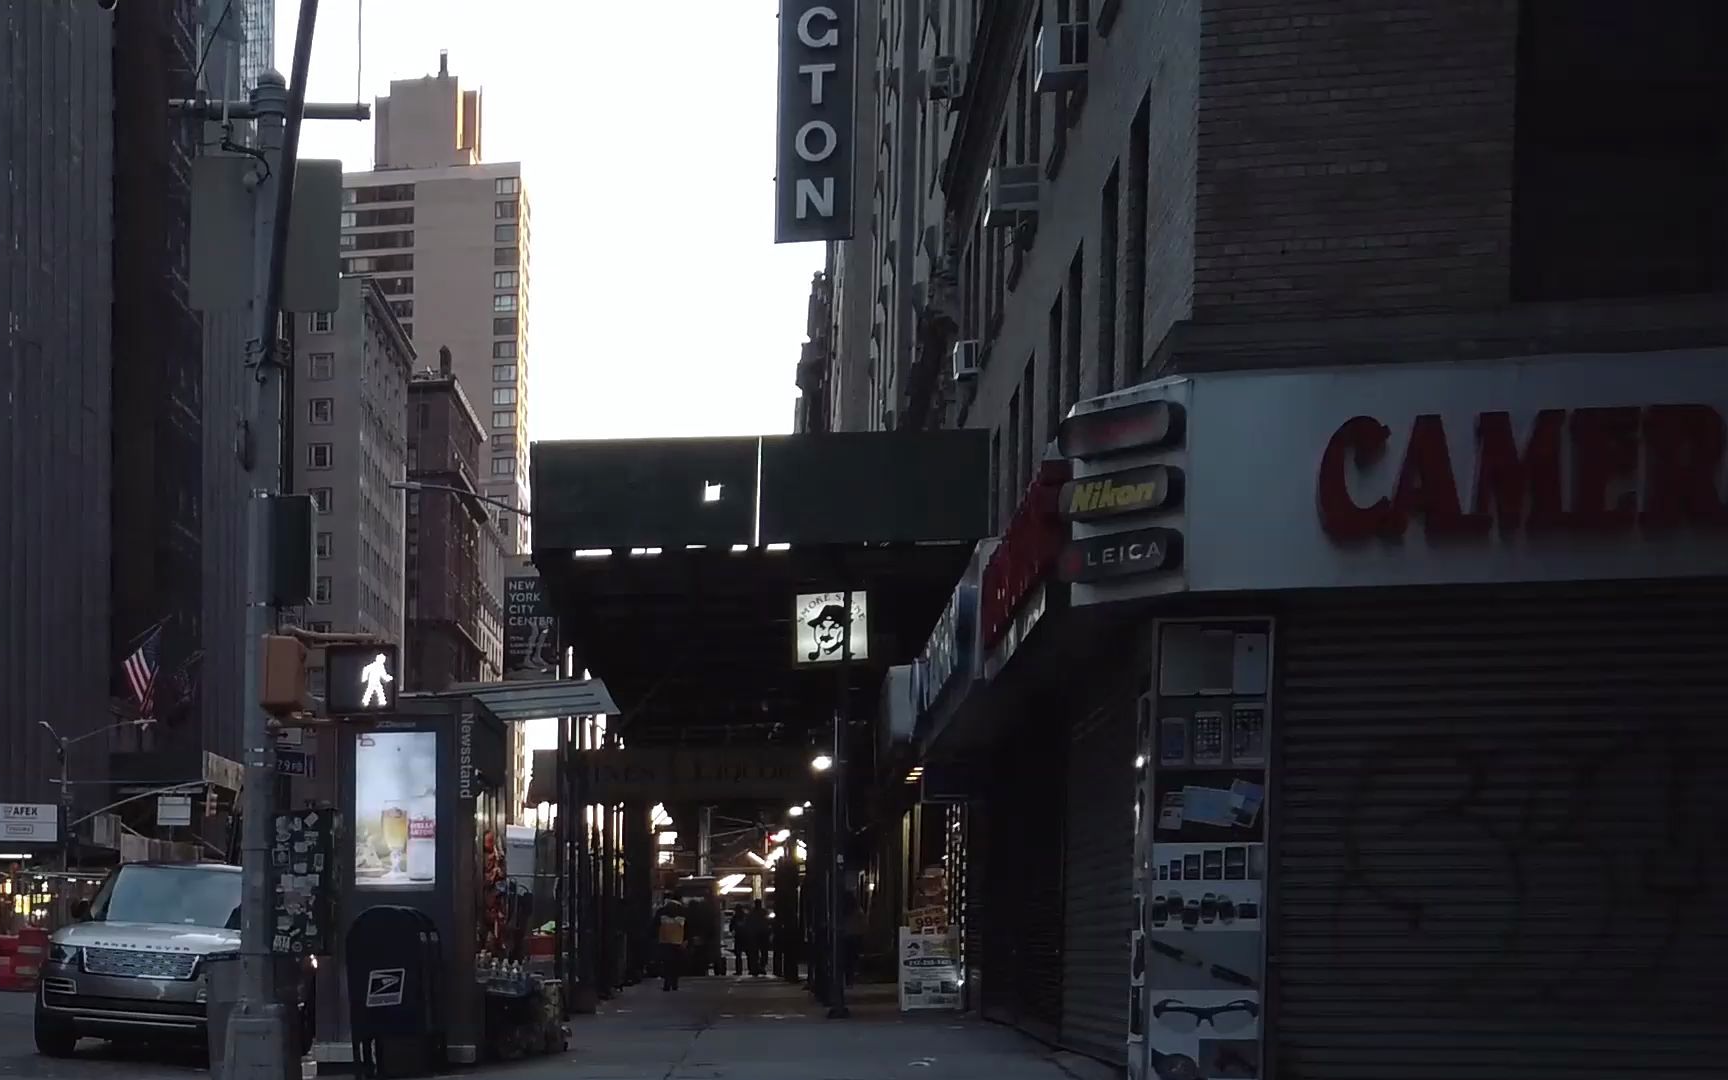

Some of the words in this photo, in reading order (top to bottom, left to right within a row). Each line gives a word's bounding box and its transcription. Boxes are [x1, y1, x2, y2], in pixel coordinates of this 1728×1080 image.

[1069, 479, 1155, 512] Nikon
[1087, 541, 1161, 567] LEICA
[509, 581, 536, 591] NEW
[509, 593, 541, 602] YORK
[509, 605, 535, 614] CITY
[509, 616, 553, 626] CENTER
[460, 713, 474, 799] Newsstand
